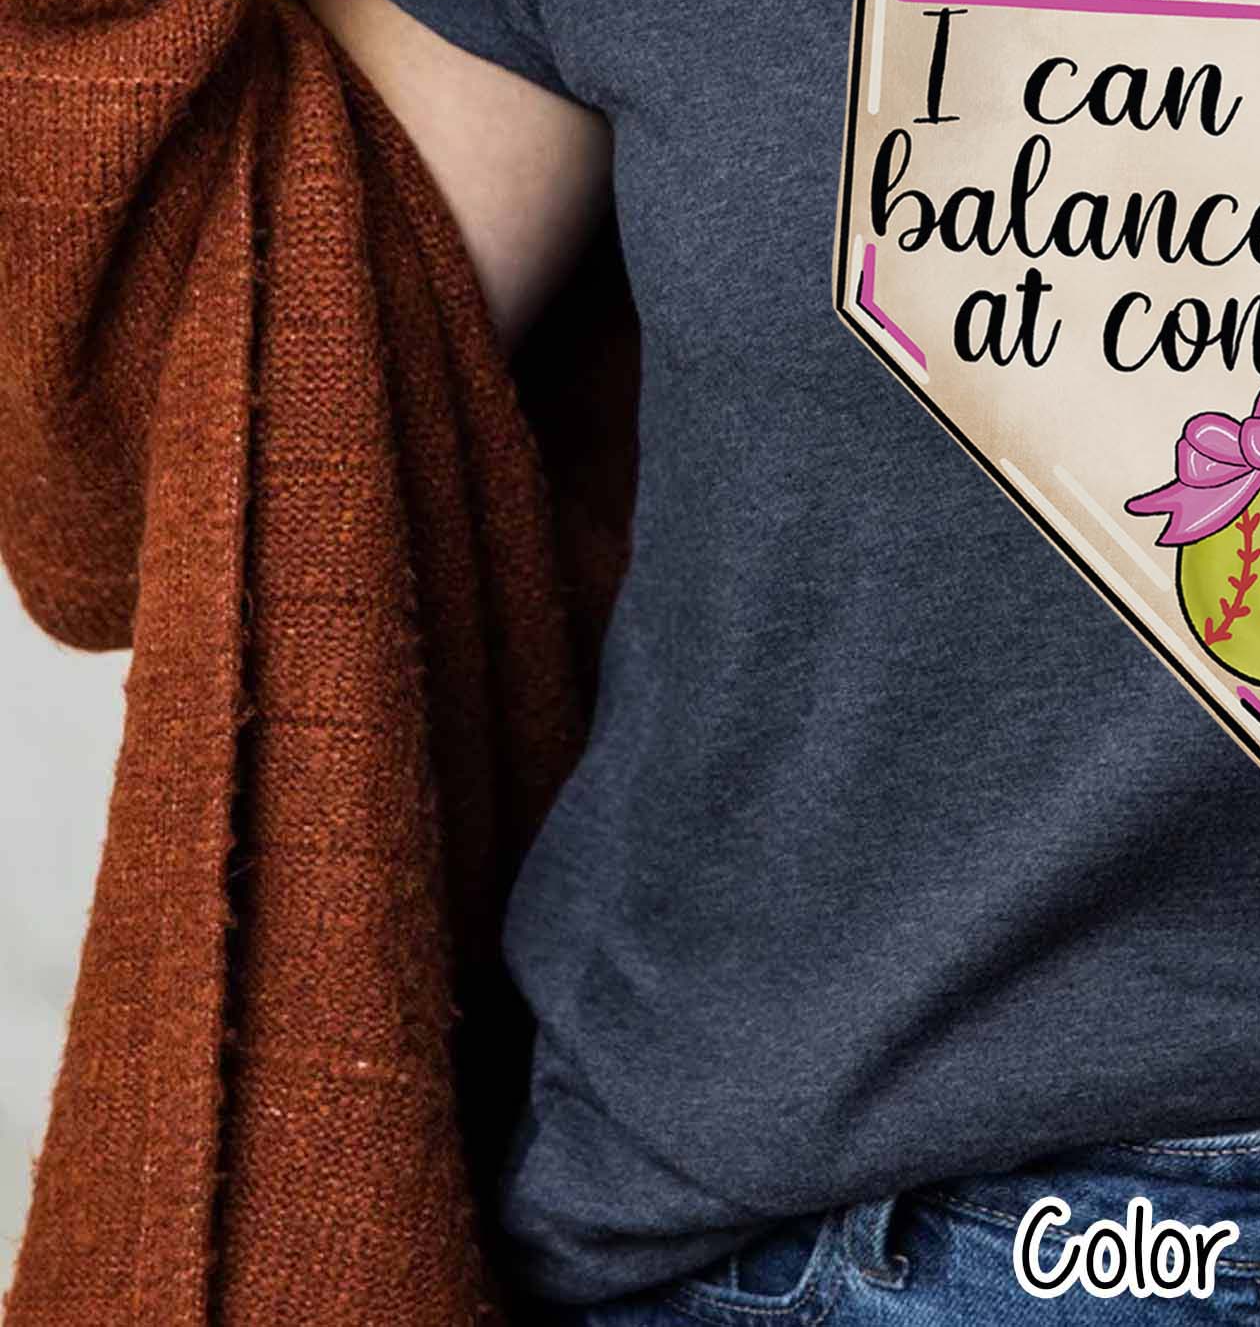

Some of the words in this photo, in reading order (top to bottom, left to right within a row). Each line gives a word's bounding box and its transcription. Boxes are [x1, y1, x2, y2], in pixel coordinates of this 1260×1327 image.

[914, 8, 969, 125] I
[1021, 55, 1242, 136] can
[953, 268, 1061, 367] at
